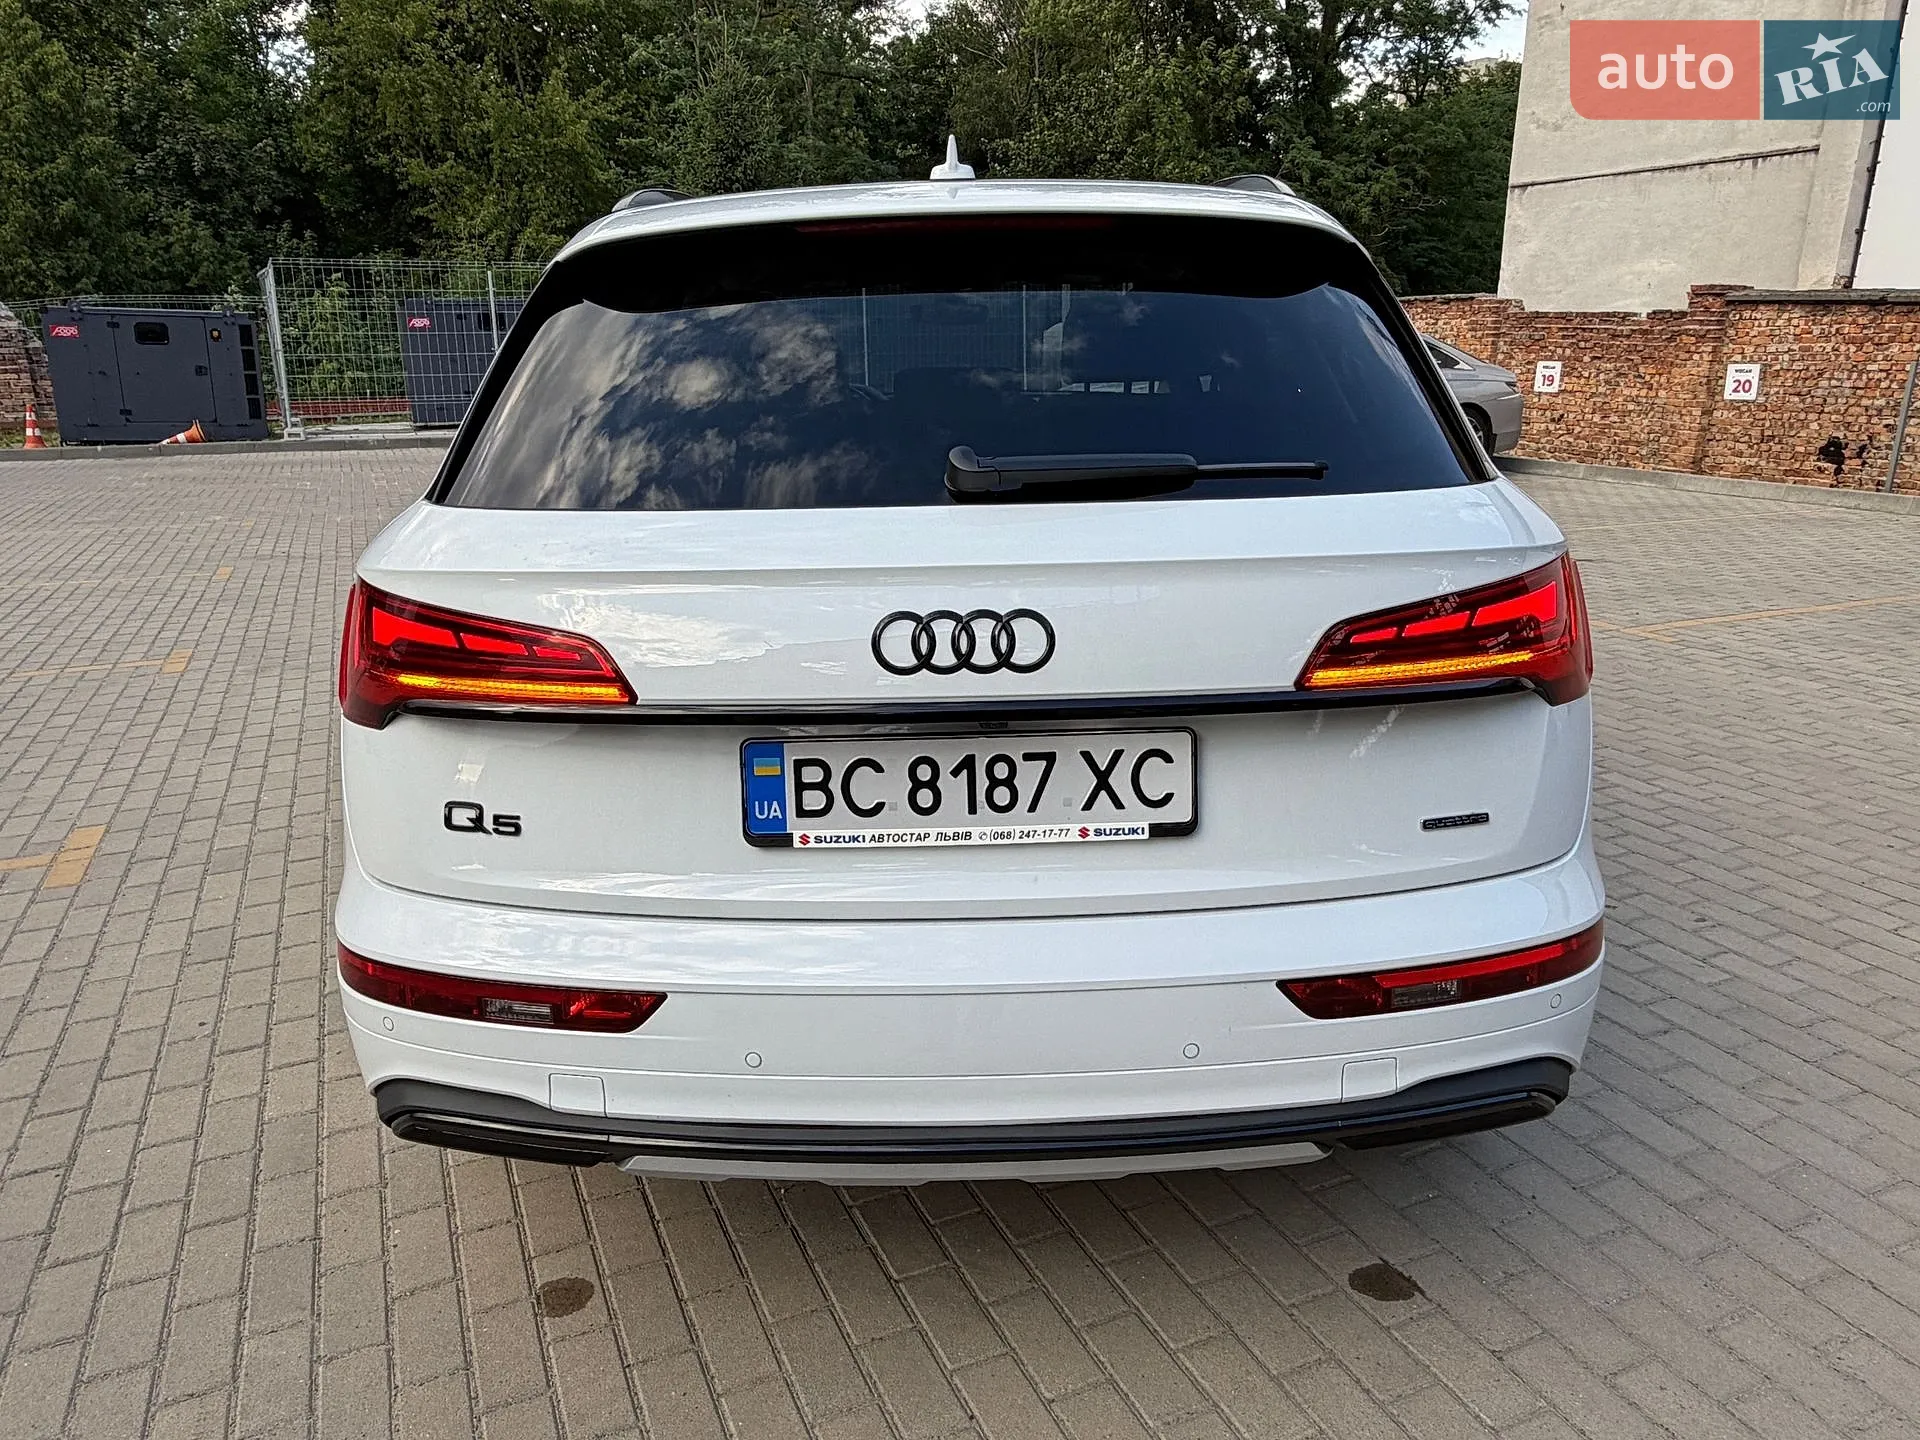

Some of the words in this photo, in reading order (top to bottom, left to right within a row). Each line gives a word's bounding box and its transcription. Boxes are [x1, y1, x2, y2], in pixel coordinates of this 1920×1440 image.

[1541, 374, 1555, 387] 19
[1731, 379, 1753, 394] 20
[907, 752, 1057, 815] 8187
[444, 800, 522, 837] Q5
[755, 800, 782, 820] UA
[814, 835, 866, 845] SUZUKI
[868, 832, 932, 844] АВТОСТАР
[934, 831, 973, 843] ЛЬВІВ
[989, 829, 1016, 842] (068)
[1018, 828, 1071, 840] 247-17-77
[1093, 826, 1146, 838] SUZUKI
